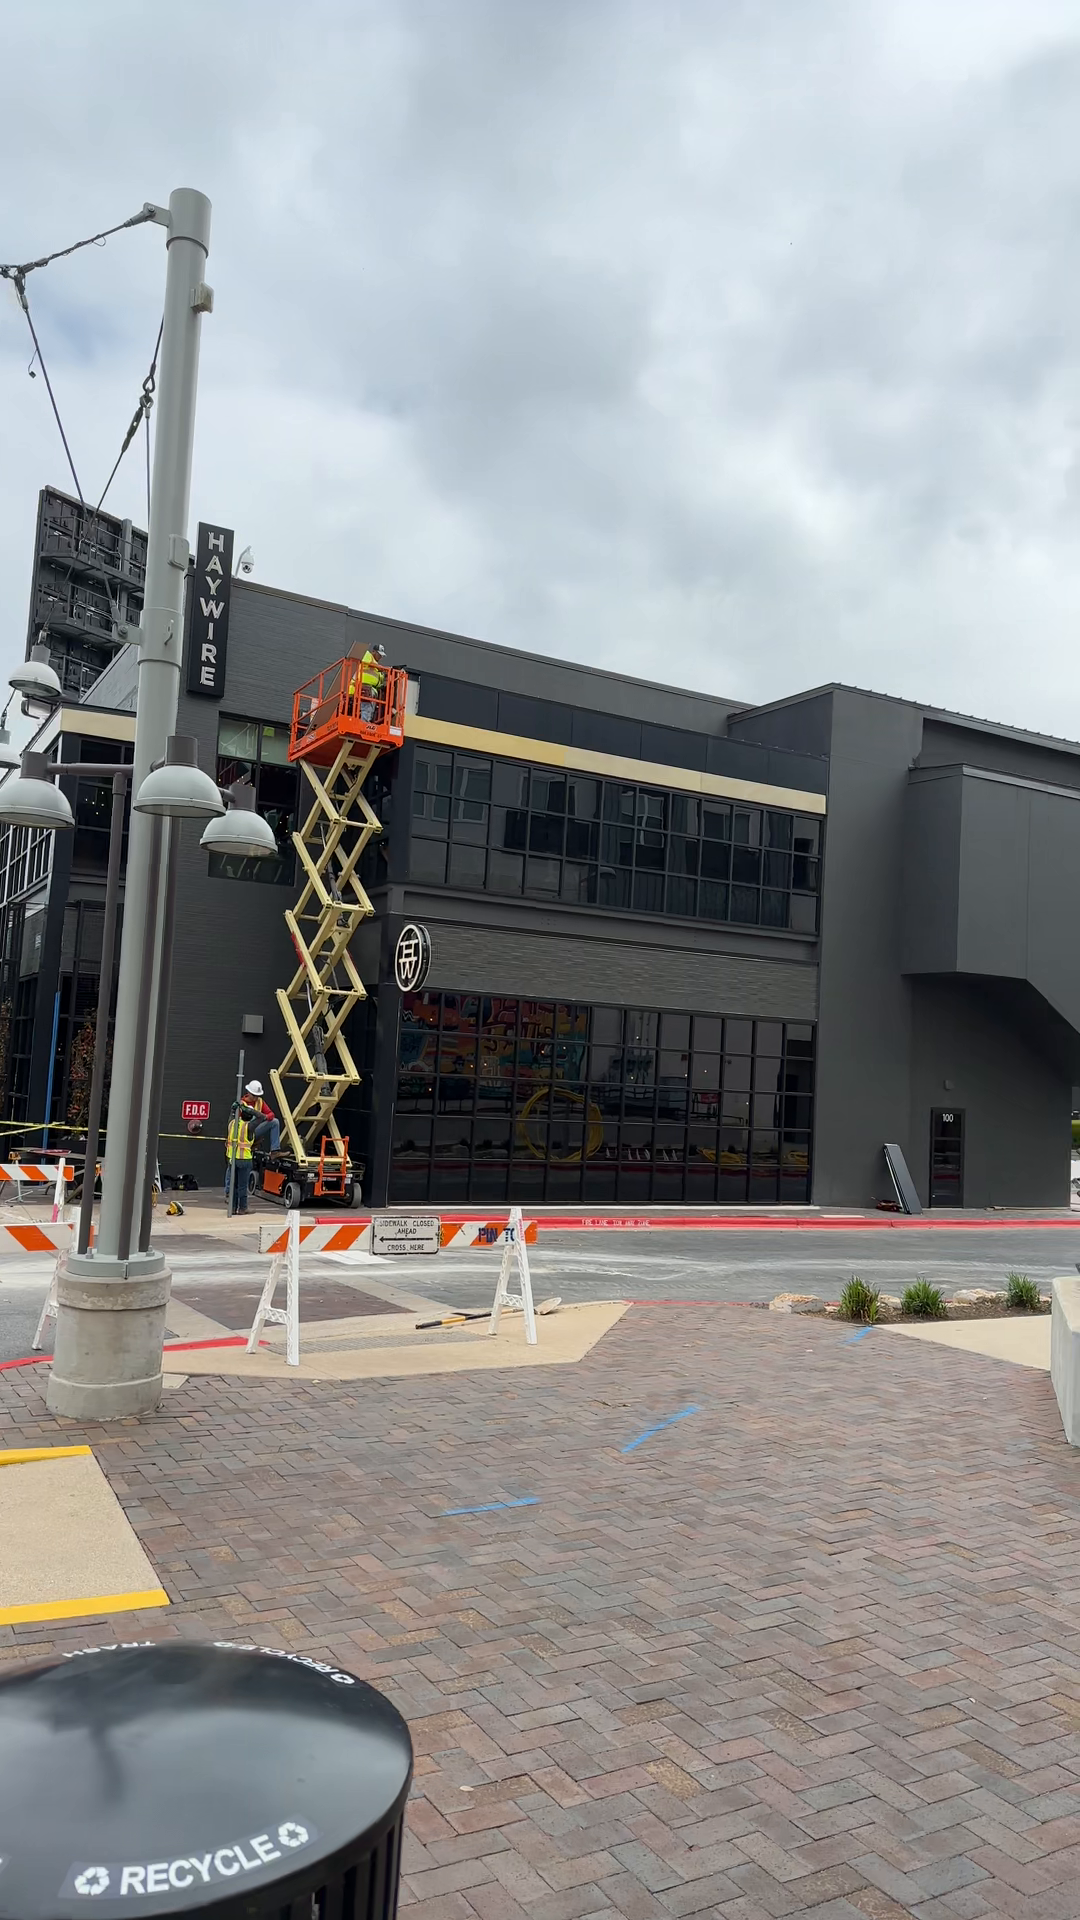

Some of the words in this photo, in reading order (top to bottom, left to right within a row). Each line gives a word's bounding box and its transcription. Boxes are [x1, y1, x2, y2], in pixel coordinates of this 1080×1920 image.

[199, 531, 226, 687] HAYWIRE
[185, 1104, 207, 1116] F.D.C.
[942, 1113, 954, 1123] 100
[397, 1227, 417, 1235] AHEAD
[238, 1643, 340, 1674] RECYCLE
[119, 1833, 282, 1896] RECYCLE
